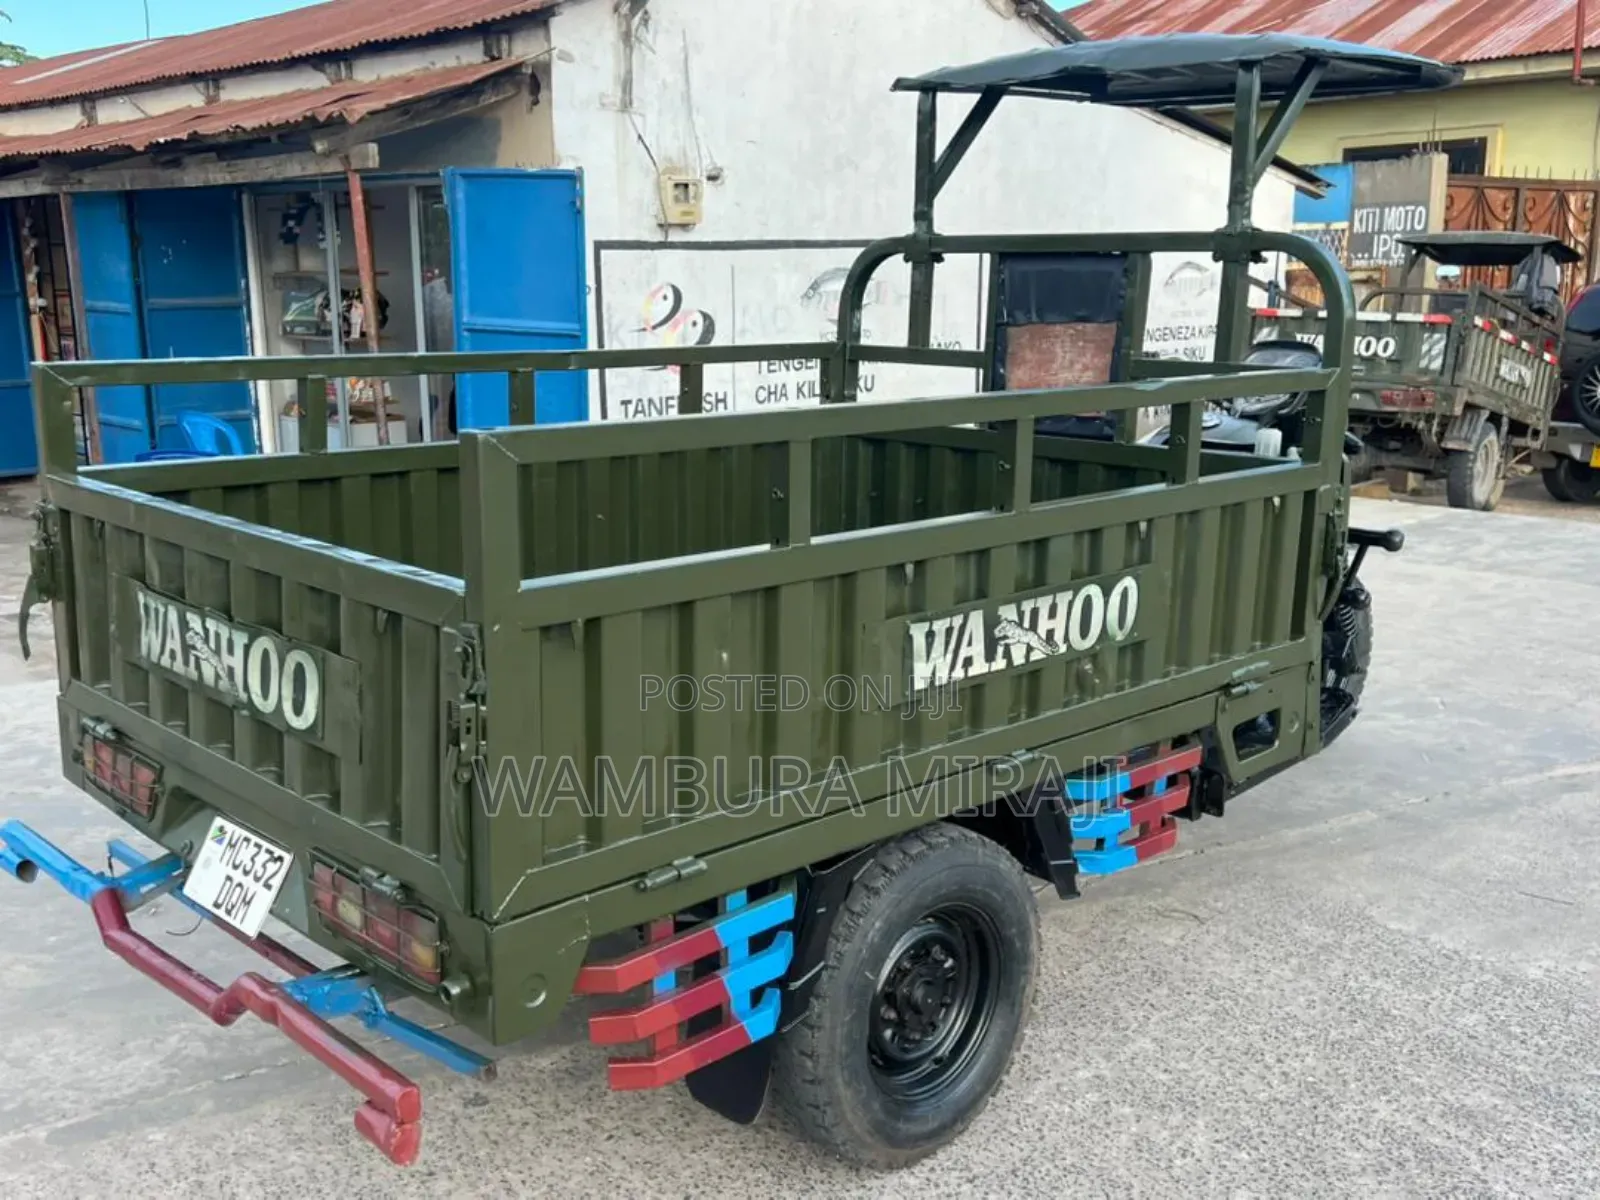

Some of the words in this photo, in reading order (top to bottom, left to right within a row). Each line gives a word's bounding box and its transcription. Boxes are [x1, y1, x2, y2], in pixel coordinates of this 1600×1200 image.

[1353, 207, 1380, 234] KITI
[1383, 205, 1426, 232] MOTO
[1145, 324, 1196, 343] NGENEZA
[620, 391, 728, 418] TANFSH
[755, 383, 788, 405] CHA
[796, 380, 821, 400] KIL
[907, 576, 1139, 690] WANHOO
[137, 587, 320, 731] WANHOO
[212, 873, 257, 925] DQM
